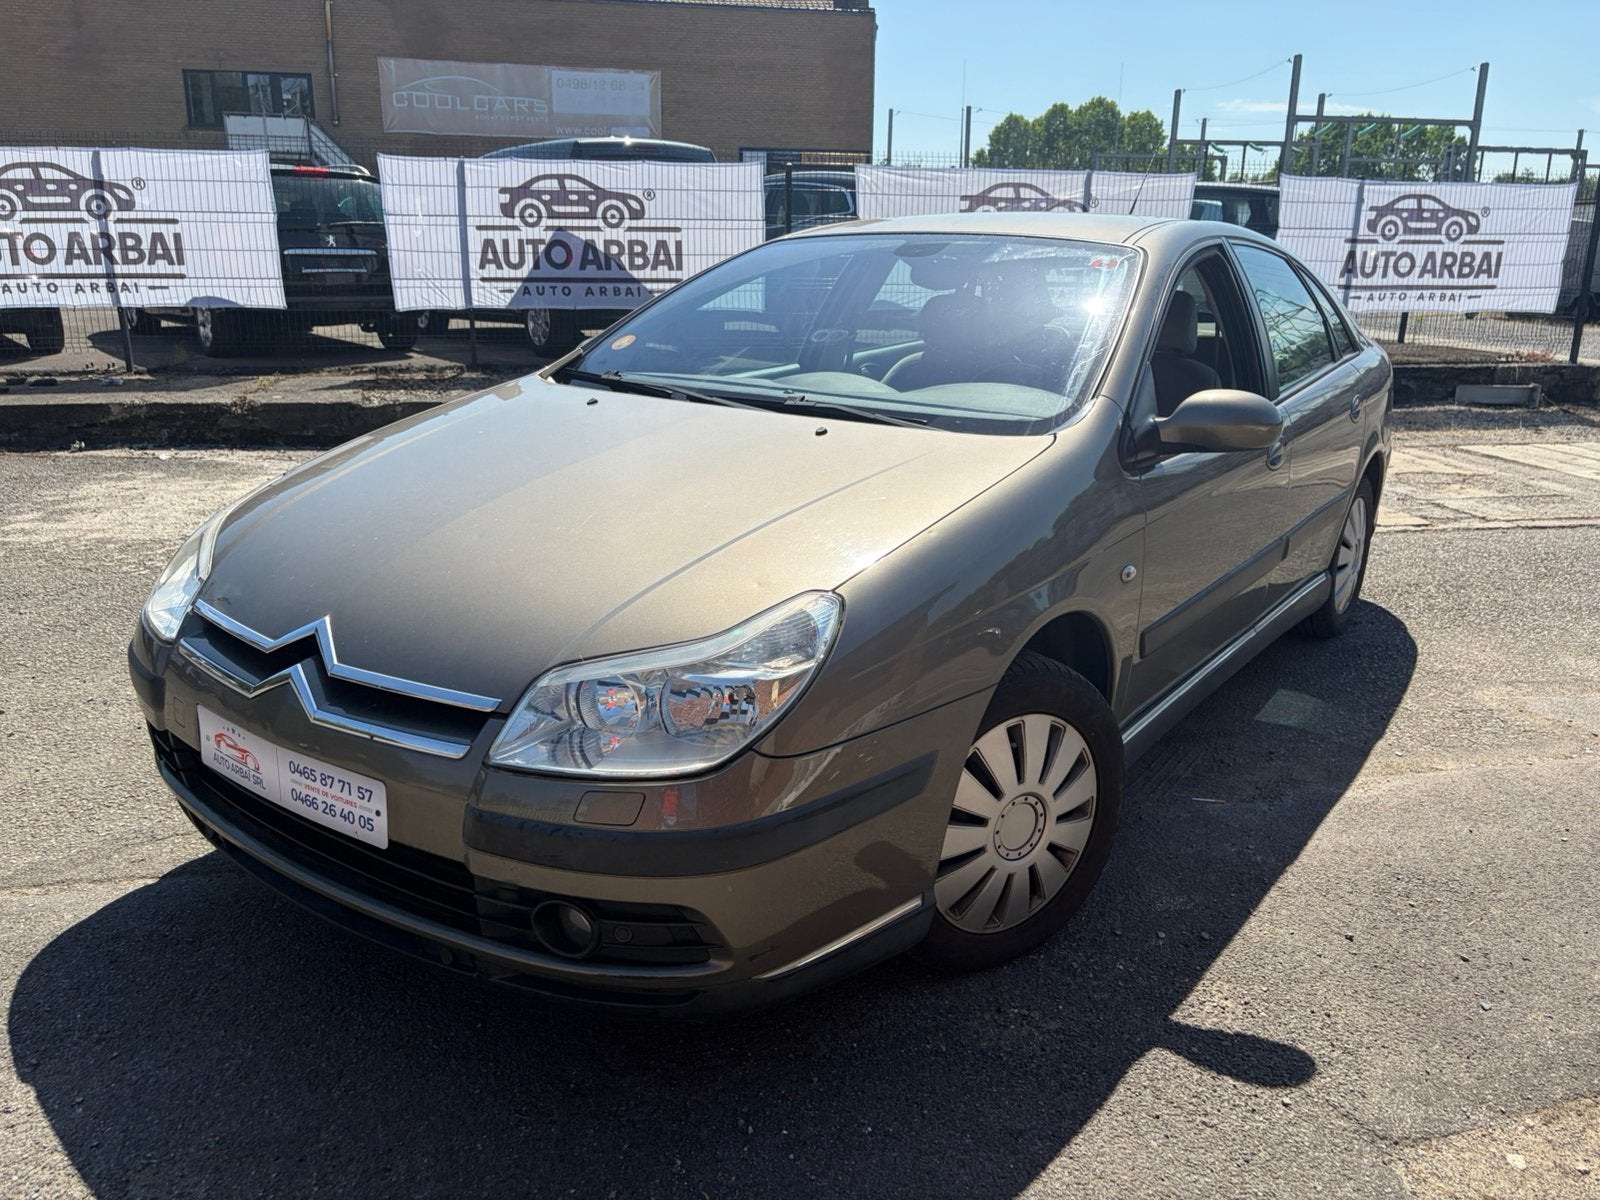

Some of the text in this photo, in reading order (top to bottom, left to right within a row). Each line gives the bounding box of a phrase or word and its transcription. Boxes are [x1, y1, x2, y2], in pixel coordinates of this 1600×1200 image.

[65, 231, 186, 266] ARBAI
[478, 238, 683, 271] AUTO ARBAI
[1339, 250, 1503, 279] AUTO ARBAI
[2, 282, 140, 294] AUTO ARBAI
[522, 285, 642, 297] AUTO ARBAI
[1366, 292, 1462, 302] AUTO ARBAI
[213, 752, 230, 770] AUTO
[252, 773, 267, 791] SRL
[288, 760, 374, 803] 0465 87 71 57
[290, 788, 375, 832] 0466 26 40 05
[303, 783, 358, 809] VENTE DE VOITURES
